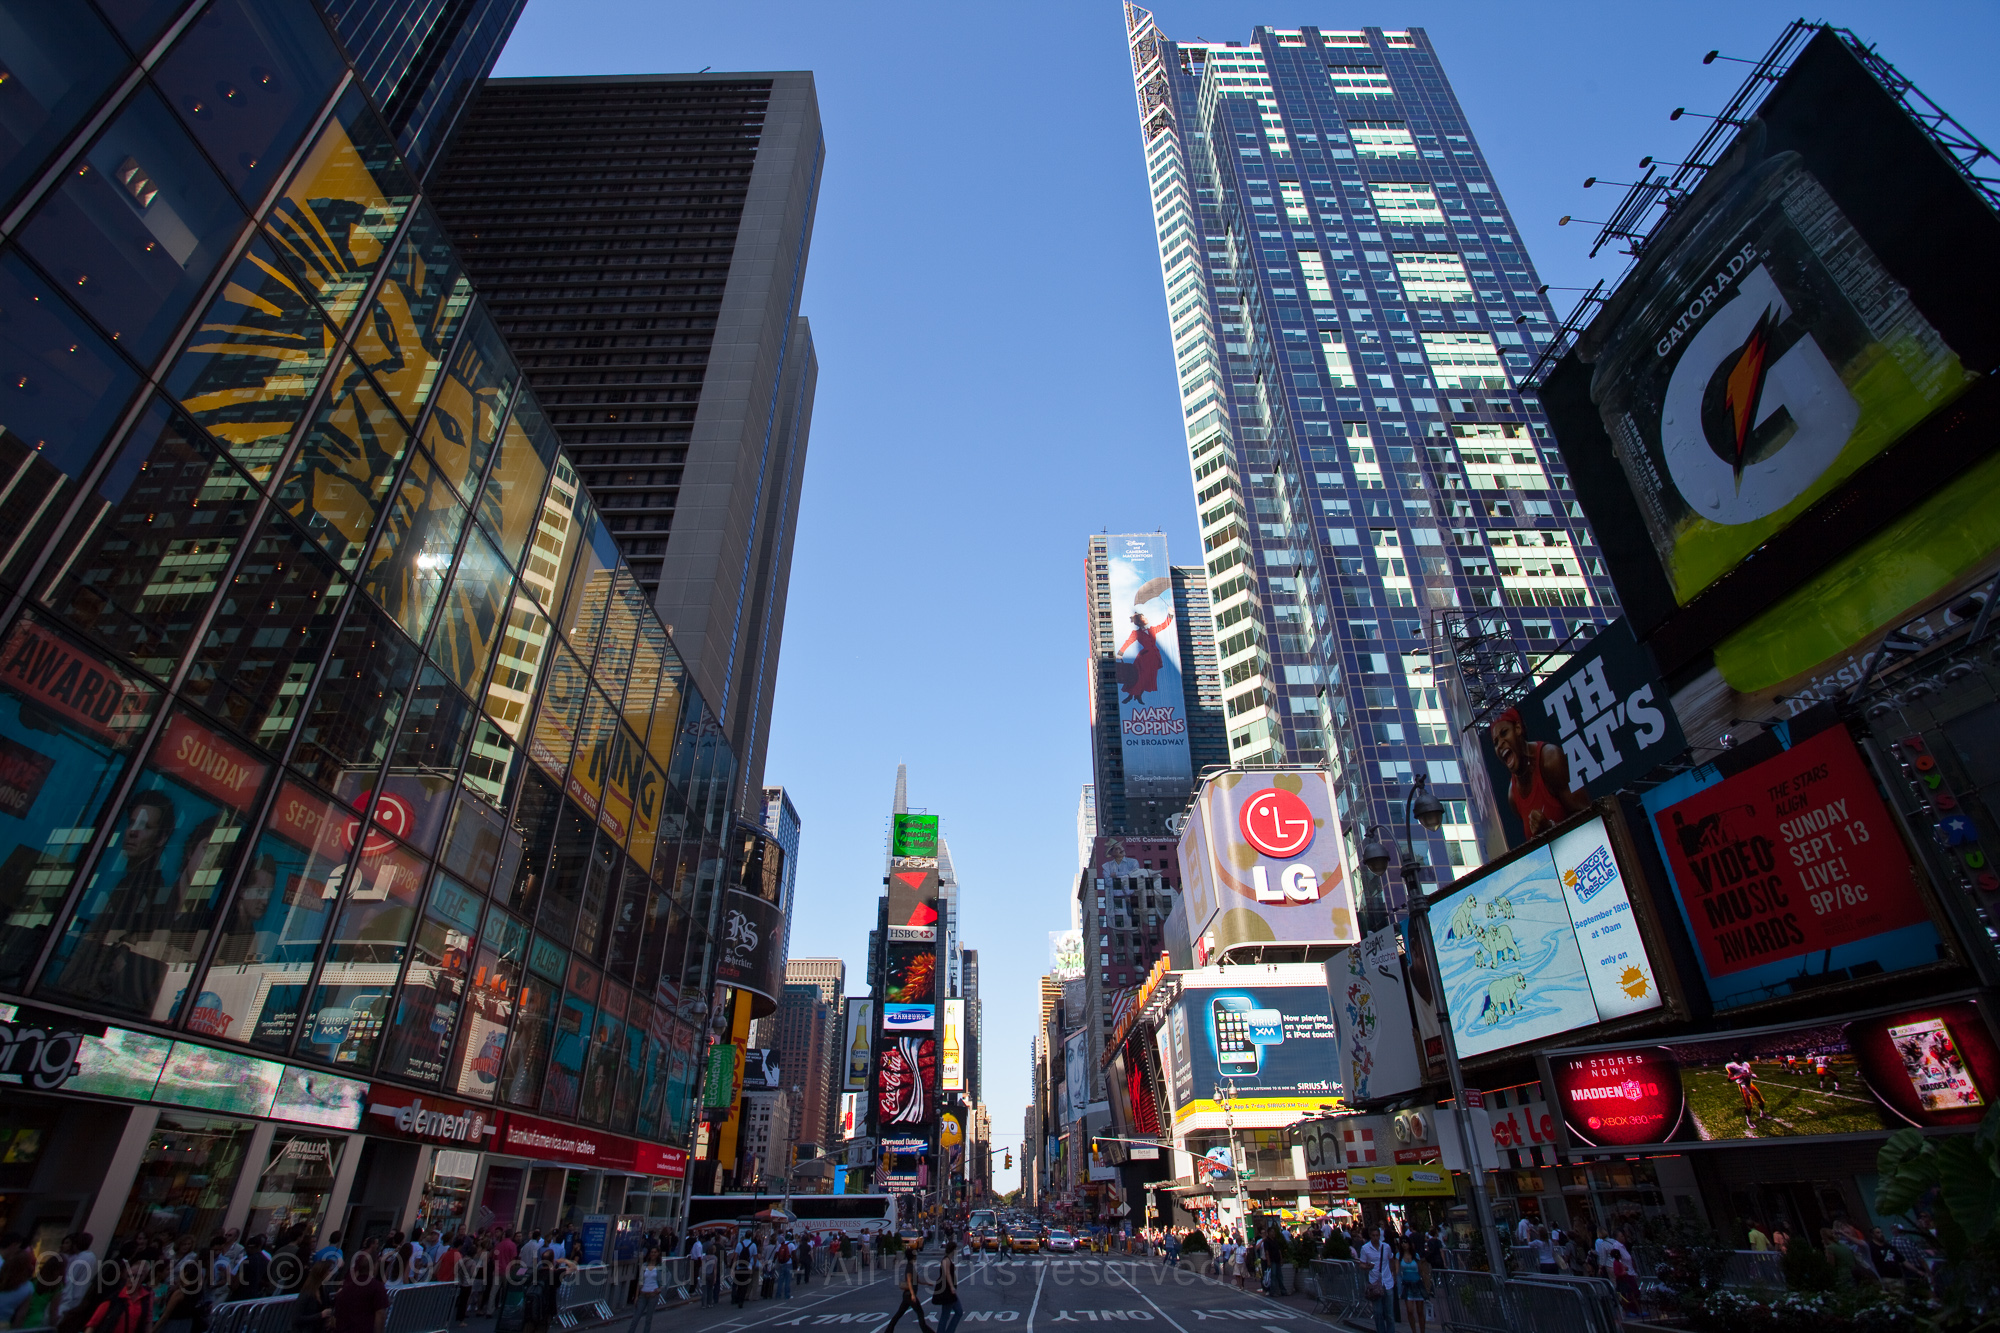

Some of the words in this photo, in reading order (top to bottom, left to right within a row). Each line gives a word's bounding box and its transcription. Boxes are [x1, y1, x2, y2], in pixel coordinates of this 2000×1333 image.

[1656, 242, 1758, 358] GATORADE
[1625, 411, 1663, 491] LEMON-LIME
[1619, 417, 1639, 458] THIRST
[1636, 458, 1667, 524] QUENCHER
[1125, 540, 1145, 548] Disney
[1132, 706, 1175, 722] MARY
[1122, 718, 1185, 736] POPPINS
[1141, 738, 1184, 746] BROADWAY
[1562, 683, 1665, 794] AT'S
[177, 735, 250, 793] SUNDAY
[1768, 783, 1791, 802] THE
[1793, 763, 1829, 791] STARS
[571, 780, 583, 791] ON
[583, 793, 597, 811] 45TH
[1775, 793, 1809, 819] ALIGN
[285, 800, 322, 838] SEPT.
[325, 822, 342, 849] 13
[602, 808, 619, 832] STREET
[1779, 798, 1849, 843] SUNDAY
[1789, 833, 1843, 867] SEPT.
[1844, 820, 1870, 846] 13
[1689, 834, 1776, 895] VIDEO
[1799, 857, 1850, 891] LIVE!
[1252, 863, 1320, 903] LG
[1703, 875, 1790, 930] MUSIC
[1809, 884, 1868, 916] 9P/8c
[1575, 909, 1612, 929] September
[1613, 901, 1630, 913] 18th
[1856, 912, 1883, 927] BRAND
[890, 929, 919, 938] HSBC
[1591, 929, 1599, 939] at
[1601, 922, 1622, 936] 10am
[1717, 913, 1805, 965] AWARDS
[534, 946, 564, 976] ALIGN
[1371, 952, 1391, 966] swatch
[1600, 953, 1616, 966] only
[1618, 951, 1628, 959] on
[1251, 1018, 1278, 1027] SIRIUS
[1301, 1014, 1328, 1024] playing
[1255, 1027, 1276, 1036] XM
[1296, 1024, 1313, 1032] your
[1569, 1061, 1583, 1070] IN
[1590, 1055, 1643, 1068] STORES
[1591, 1067, 1626, 1077] NOW!
[1297, 1082, 1320, 1090] SIRIUS
[1571, 1086, 1624, 1101] MADDEN
[1641, 1082, 1659, 1096] 10
[1919, 1081, 1948, 1092] MADDEN
[1959, 1079, 1967, 1087] 10
[395, 1099, 470, 1140] element
[1601, 1116, 1629, 1126] XBOX
[1629, 1114, 1648, 1125] 360
[881, 1138, 905, 1146] Sherwood
[1414, 1173, 1437, 1181] swatch
[785, 1220, 829, 1228] LACKHAWK
[829, 1220, 861, 1228] EXPRESS
[773, 1311, 890, 1326] ONLY
[1051, 1309, 1155, 1322] ONLY
[1190, 1309, 1298, 1320] ONLY
